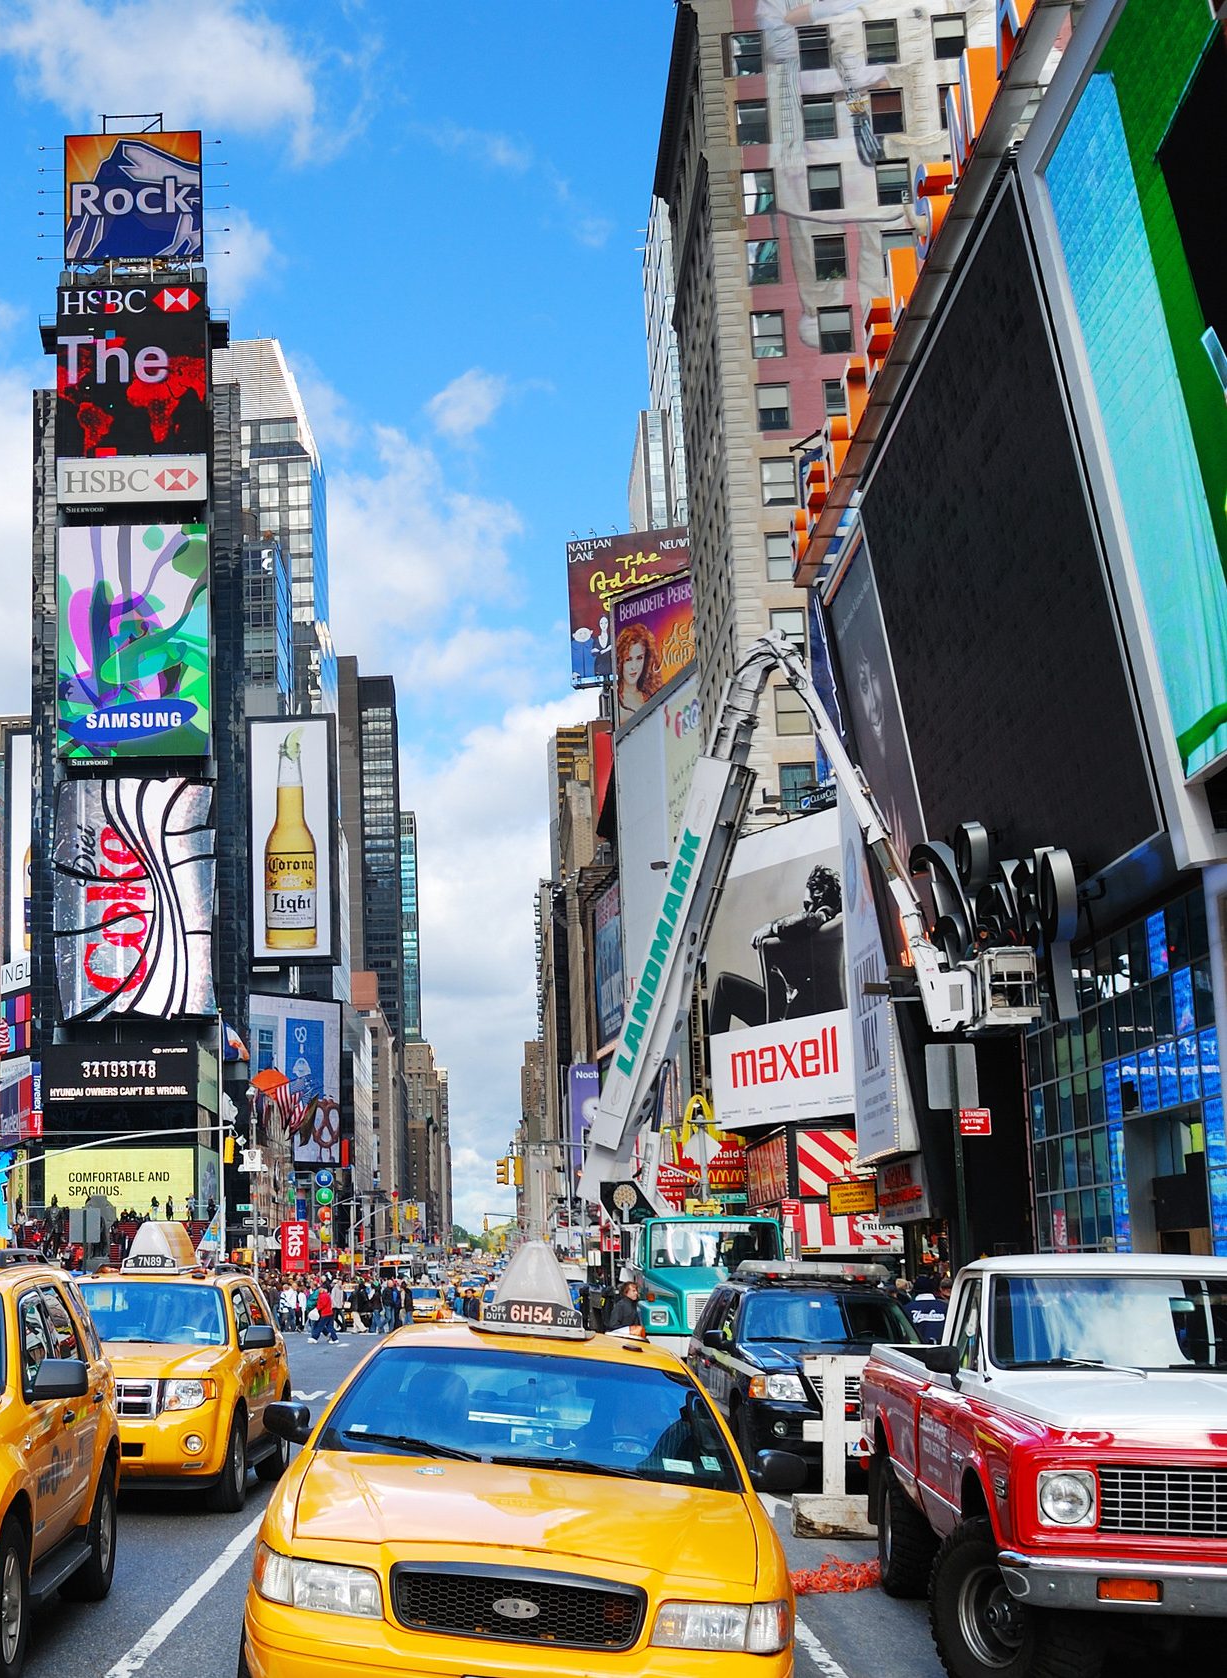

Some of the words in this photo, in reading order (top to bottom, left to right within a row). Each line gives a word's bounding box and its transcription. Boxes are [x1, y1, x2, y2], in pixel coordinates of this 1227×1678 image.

[61, 289, 147, 315] HSBC
[58, 335, 168, 384] The
[64, 469, 149, 494] HSBC
[567, 539, 613, 553] NATHAN
[568, 551, 594, 564] LANE
[615, 551, 662, 571] The
[619, 595, 665, 622] BERNADETTE
[86, 712, 182, 729] SAMSUNG
[72, 824, 99, 888] Diet
[267, 857, 315, 875] Corona
[83, 824, 148, 994] Coke
[271, 892, 312, 914] Light
[616, 827, 702, 1078] LANDMARK
[730, 1024, 840, 1090] maxell
[33, 1073, 42, 1110] Travelex
[50, 1087, 84, 1097] HYUNDAI
[85, 1087, 118, 1096] OWNERS
[119, 1086, 143, 1096] CAN'T
[144, 1086, 155, 1095] BE
[156, 1085, 188, 1095] WRONG.
[965, 1110, 988, 1118] STANDING
[68, 1171, 145, 1184] COMFORTABLE
[147, 1171, 170, 1183] AND
[68, 1185, 123, 1198] SPACIOUS.
[287, 1224, 305, 1257] tkts
[137, 1256, 162, 1267] 7N89
[486, 1312, 507, 1321] DUTY
[557, 1317, 578, 1326] DUTY
[510, 1304, 553, 1324] 6H54
